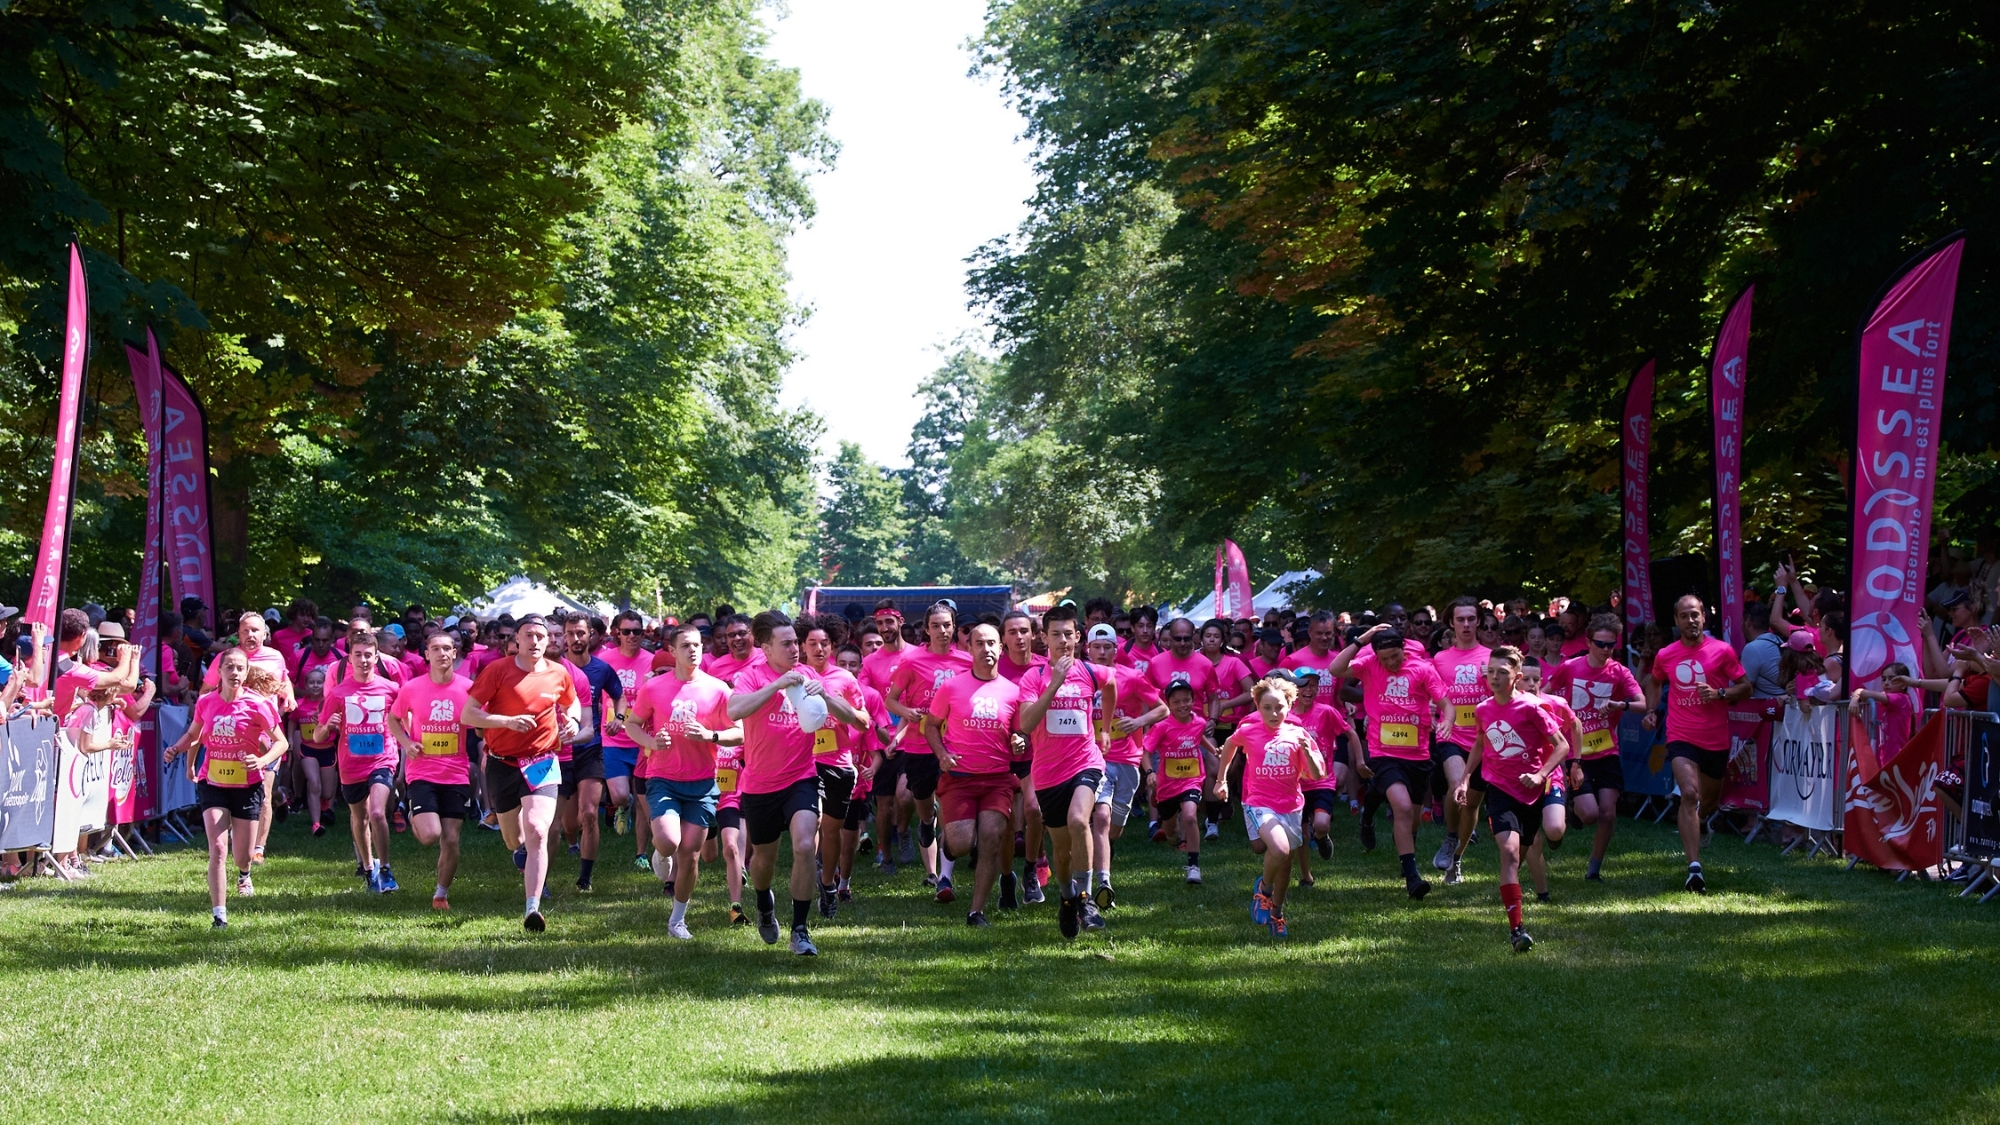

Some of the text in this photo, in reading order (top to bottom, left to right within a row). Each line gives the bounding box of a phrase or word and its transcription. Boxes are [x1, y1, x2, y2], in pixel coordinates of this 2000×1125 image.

[1861, 318, 1925, 600] ODYSSEA
[1903, 321, 1940, 604] Ensemble on est plus fort
[1625, 414, 1643, 624] ODYSSEA
[1454, 674, 1477, 684] ANS
[1384, 685, 1408, 697] ANS
[1449, 684, 1485, 693] ODYSSEA
[1051, 698, 1079, 708] DYSSEA
[1452, 695, 1479, 704] ODYSSEA
[428, 710, 454, 721] ANS
[769, 713, 799, 724] ODYSS
[971, 707, 999, 720] ANS
[1380, 713, 1410, 723] ODYSSEA
[348, 725, 376, 733] ODYSSEA
[421, 722, 450, 732] ODYSSEA
[664, 722, 685, 732] ODYS
[963, 719, 1004, 729] ODYSSEA
[212, 726, 236, 737] ANS
[209, 749, 238, 759] ODYSSEA
[1263, 754, 1290, 766] ANS
[1256, 767, 1296, 778] ODYSSEA
